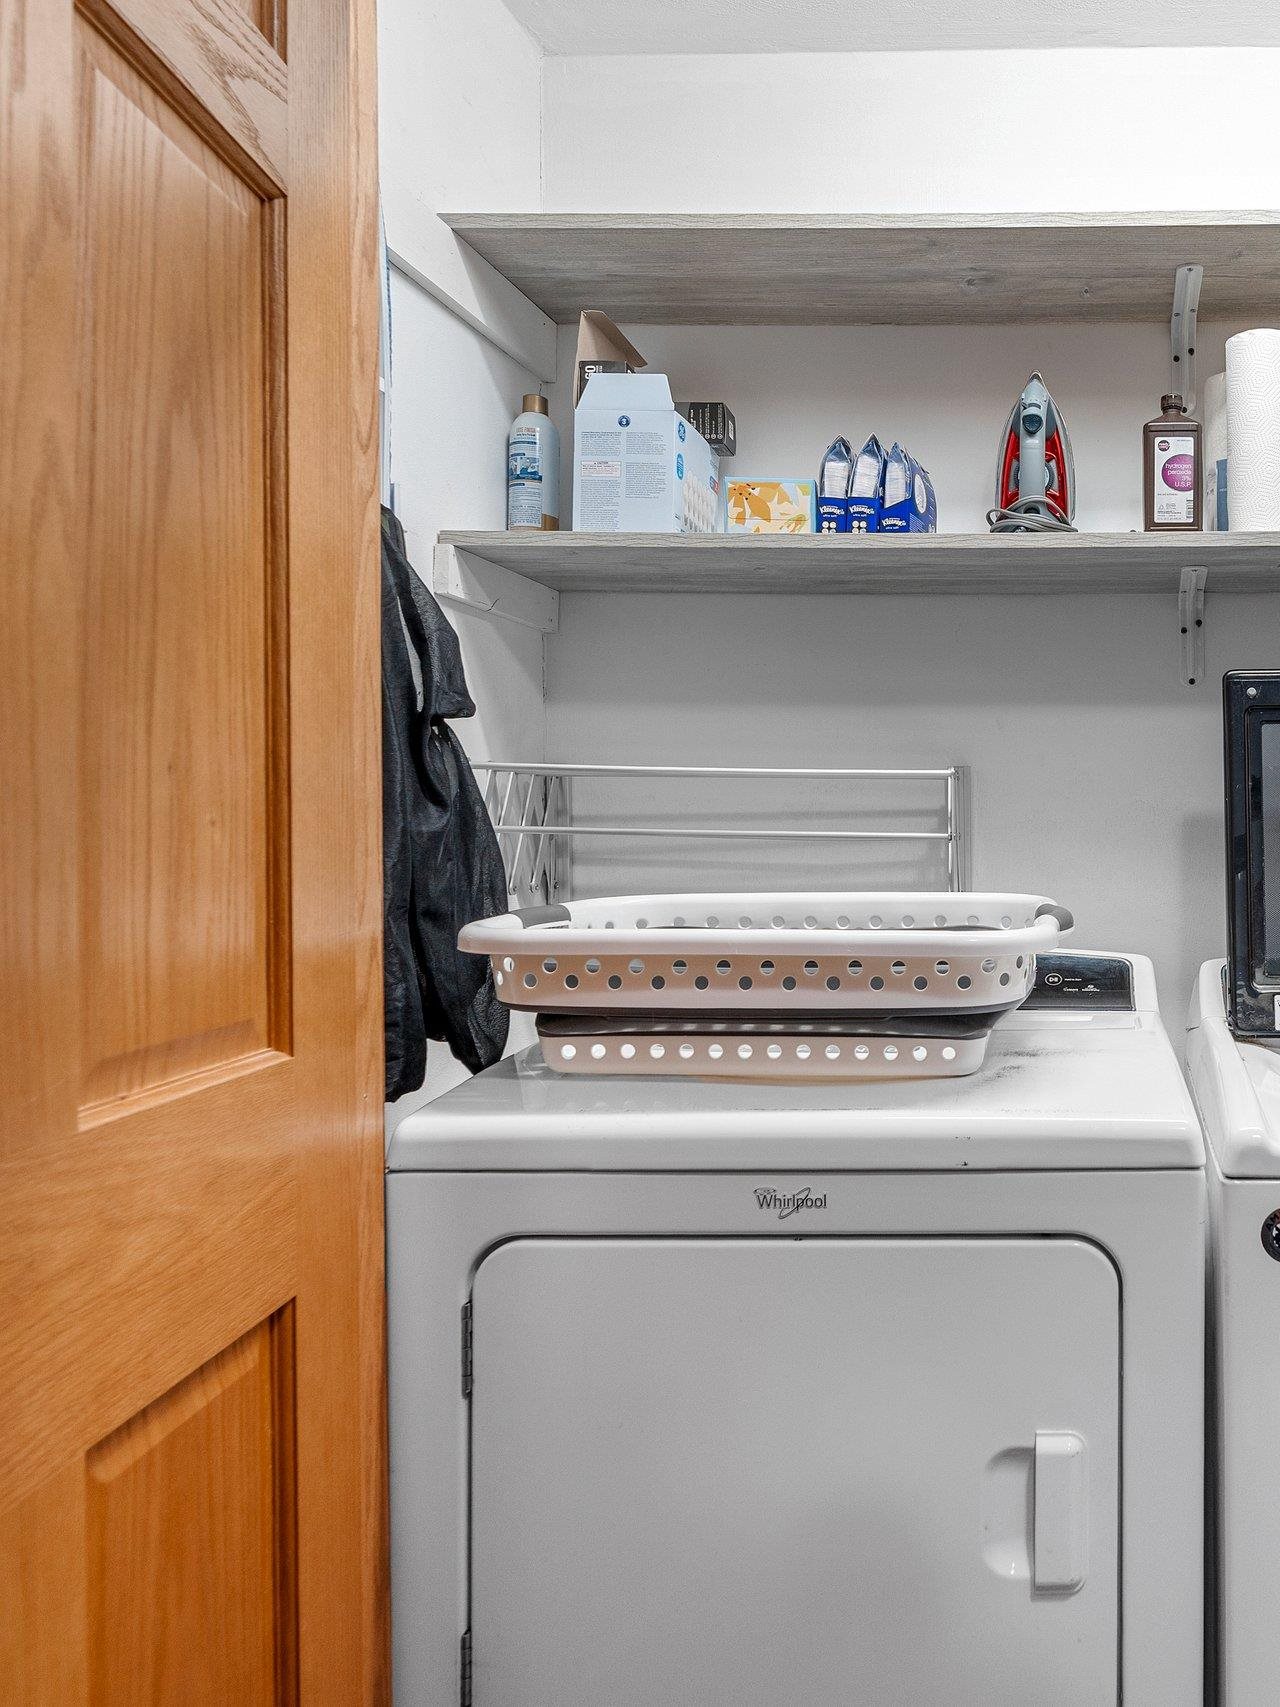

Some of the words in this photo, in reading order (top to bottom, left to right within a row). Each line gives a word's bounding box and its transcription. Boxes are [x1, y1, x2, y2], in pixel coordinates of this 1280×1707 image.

[819, 505, 843, 515] Kleenex
[849, 505, 872, 515] Kleenex
[756, 1192, 827, 1214] Whirlpool
